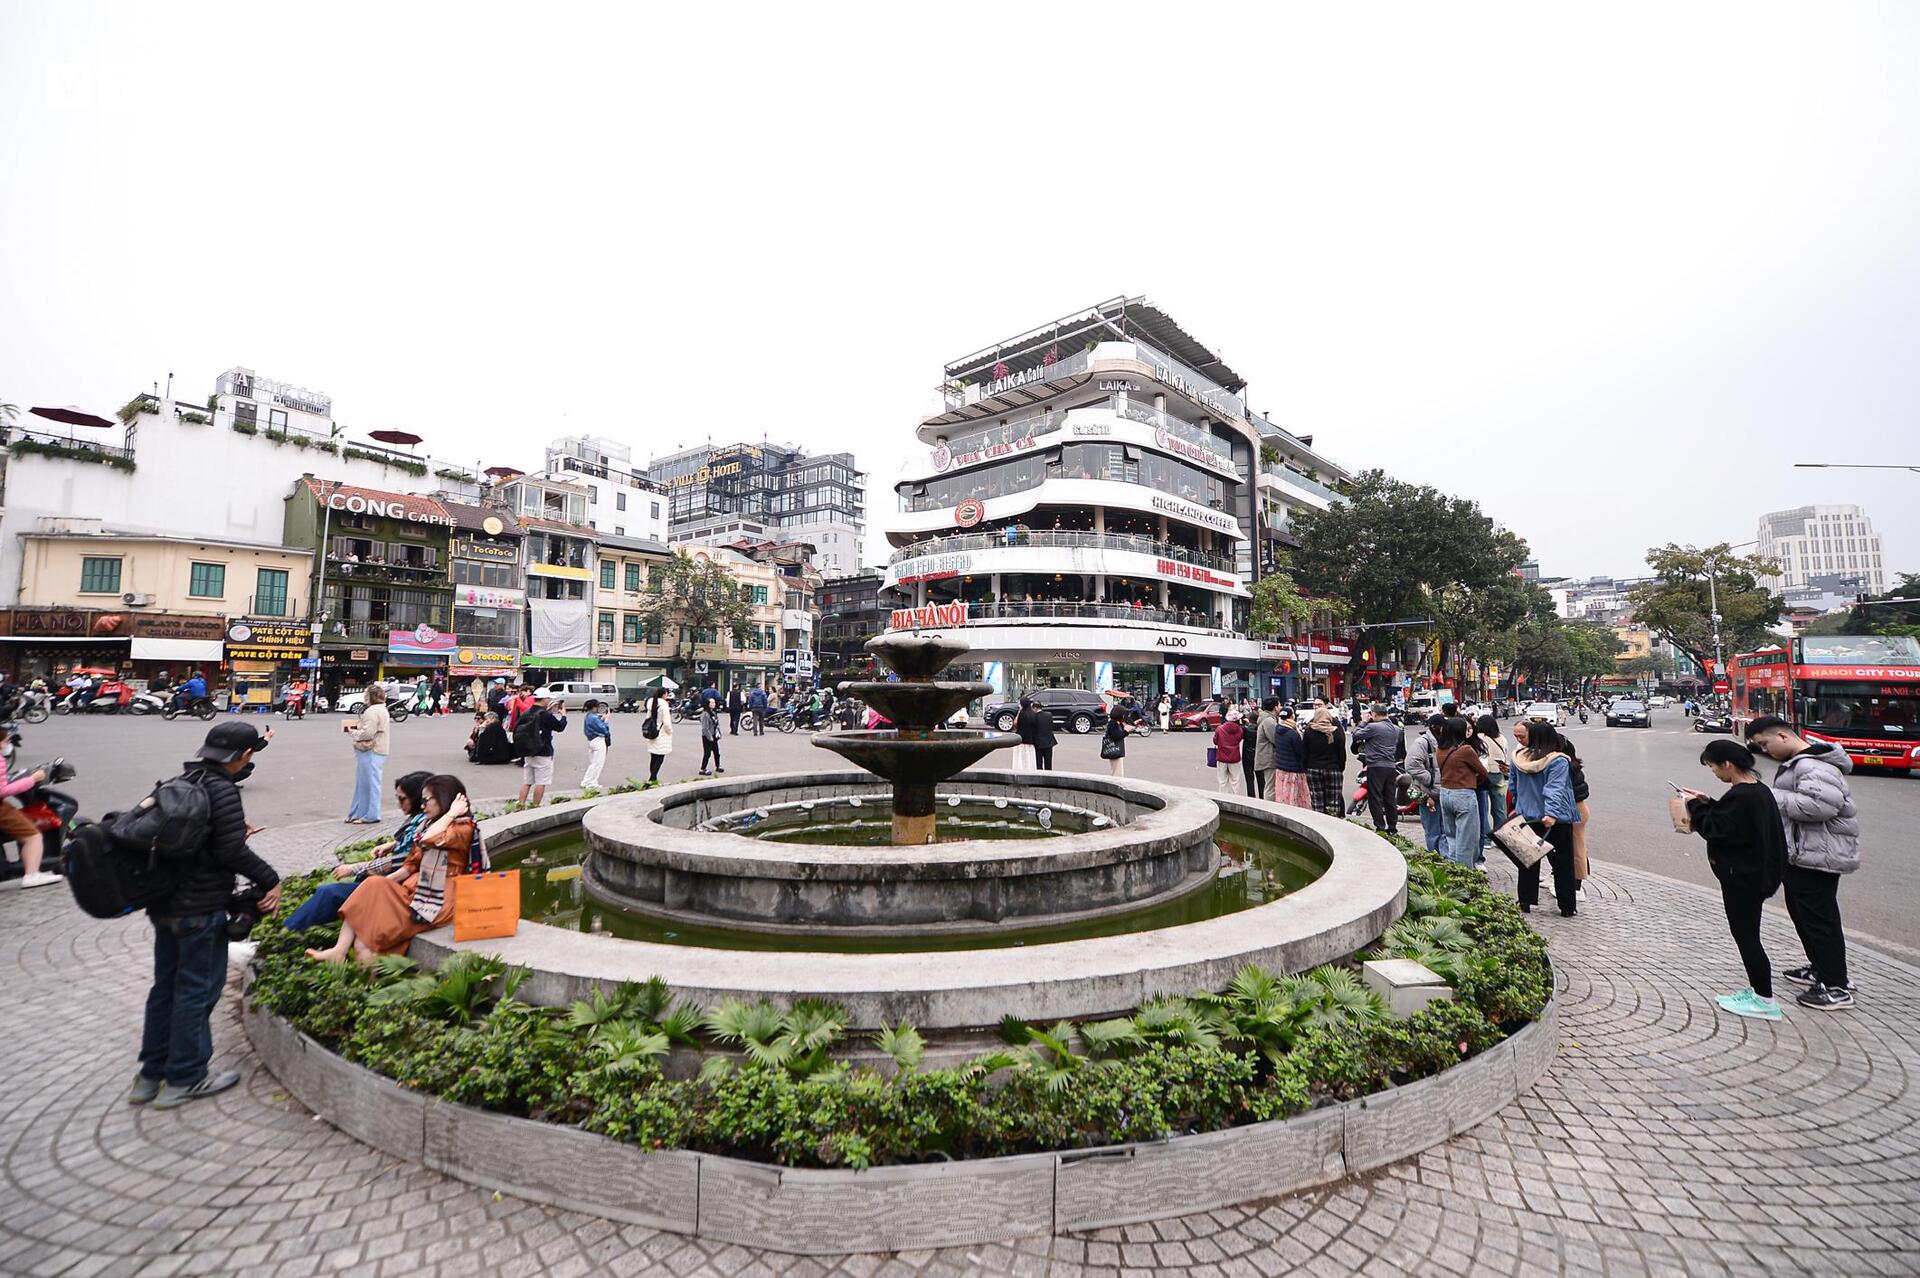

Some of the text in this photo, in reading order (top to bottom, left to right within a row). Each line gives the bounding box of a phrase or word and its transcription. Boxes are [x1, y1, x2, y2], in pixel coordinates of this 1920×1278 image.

[988, 370, 1026, 396] LAIKA
[1099, 380, 1132, 391] LAIKA
[1155, 364, 1187, 395] LAIKA
[713, 462, 742, 479] HOTEL
[1153, 497, 1235, 530] HIGHLANDS COFFEE
[892, 610, 914, 629] BIA
[1157, 636, 1187, 647] ALDO
[1811, 669, 1852, 677] HANOI
